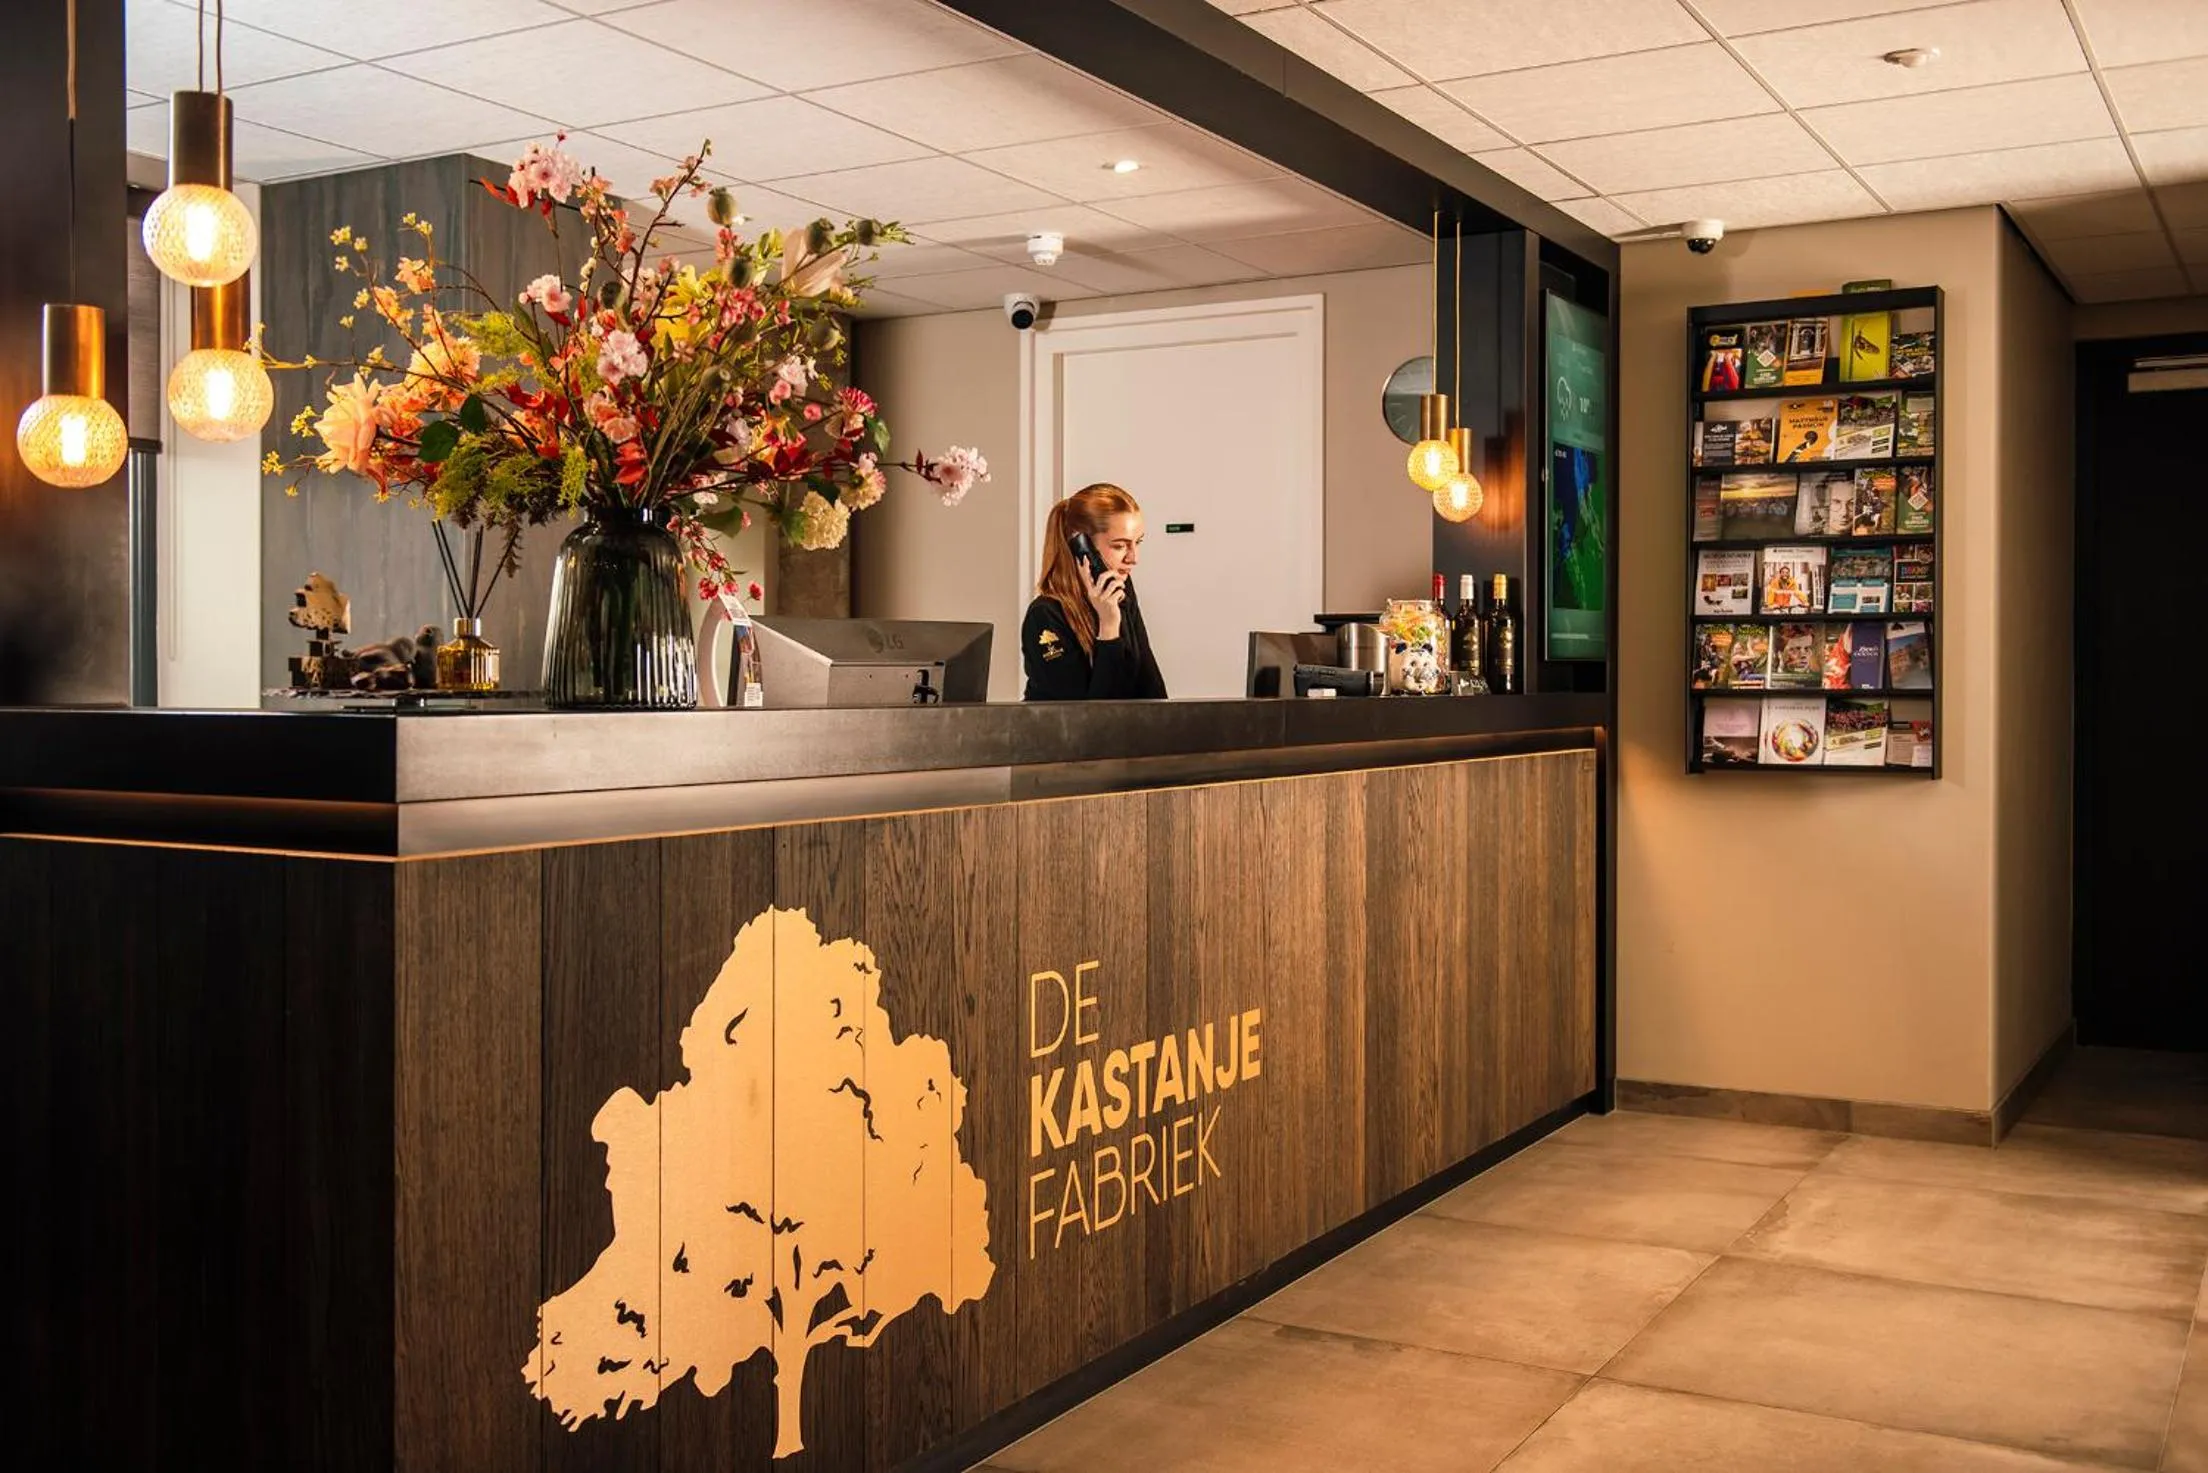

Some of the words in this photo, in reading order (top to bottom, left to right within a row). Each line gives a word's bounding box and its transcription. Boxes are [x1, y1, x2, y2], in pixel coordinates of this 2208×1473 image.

[884, 633, 905, 650] LG
[1030, 960, 1099, 1058] DE
[1030, 1008, 1261, 1158] KASTANJE
[1030, 1105, 1221, 1260] FABRIEK
